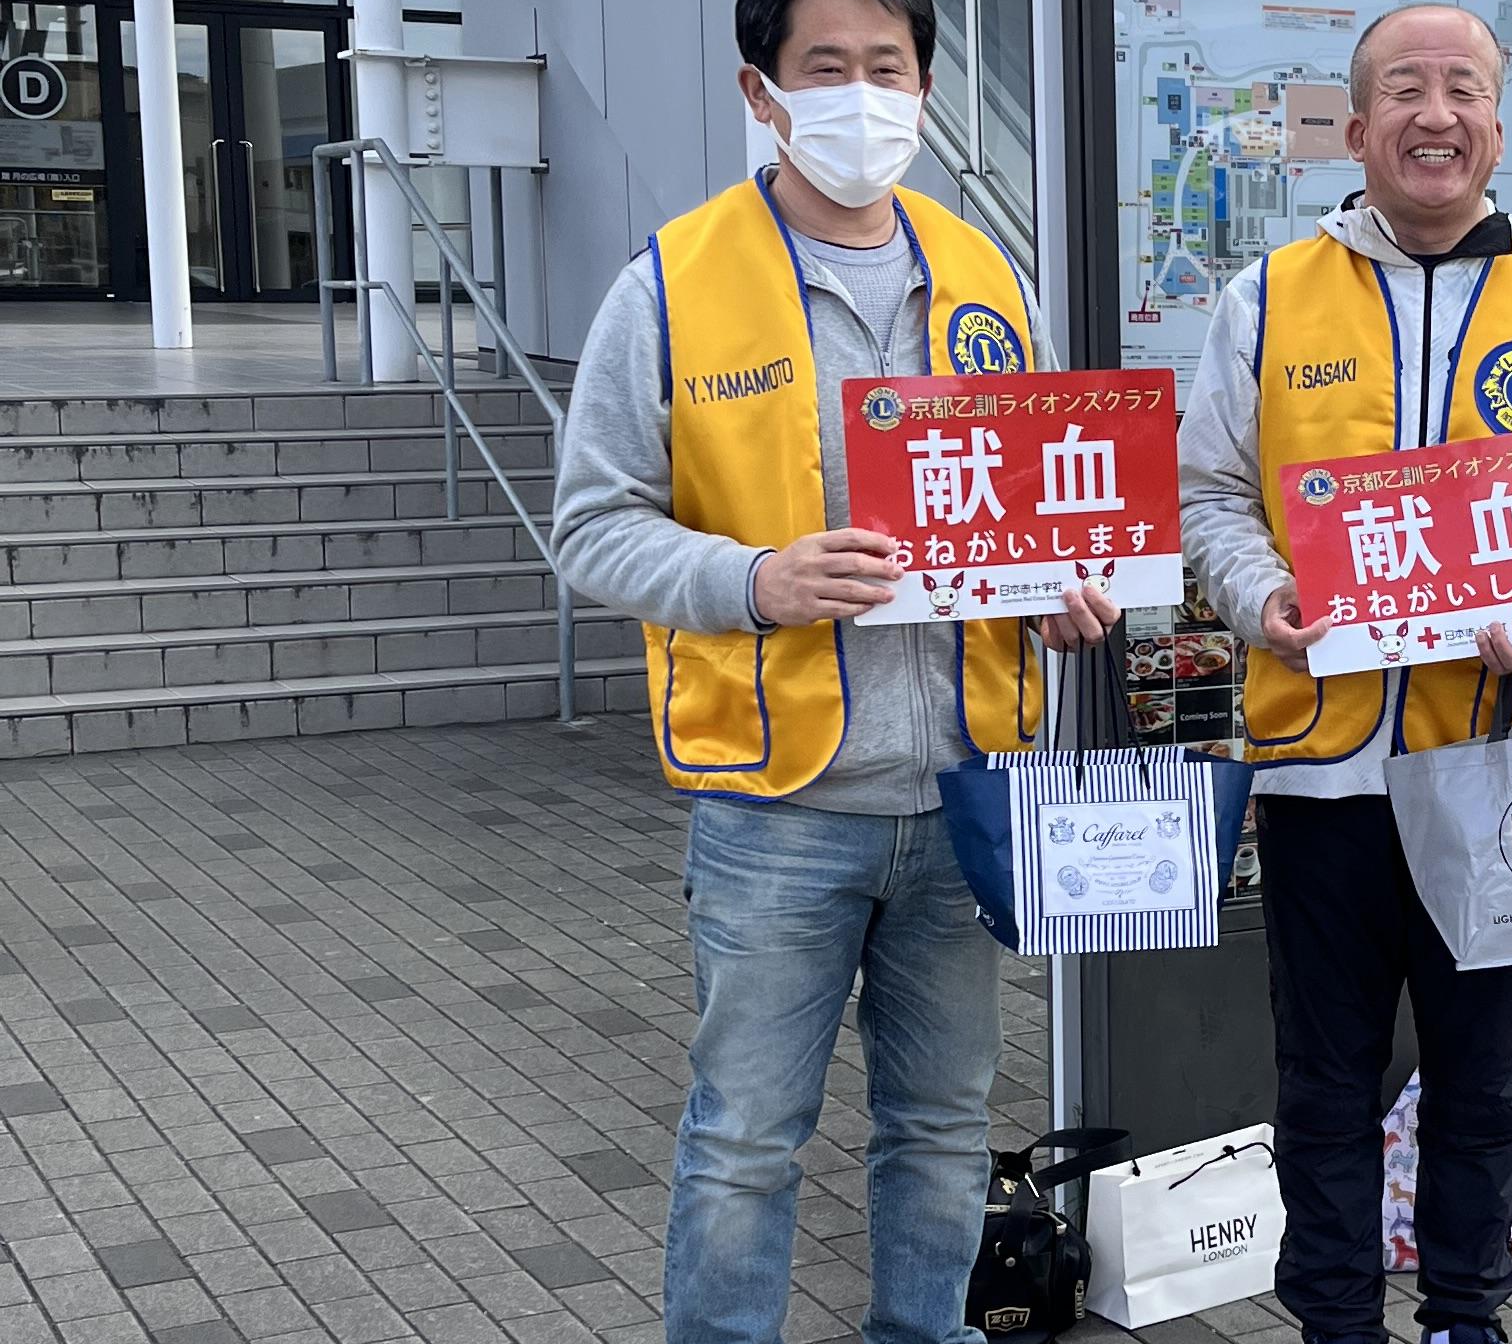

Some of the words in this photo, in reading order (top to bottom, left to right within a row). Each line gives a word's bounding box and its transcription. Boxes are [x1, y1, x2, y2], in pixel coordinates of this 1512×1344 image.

[18, 71, 49, 104] D
[963, 314, 1003, 337] LIONS
[978, 338, 1000, 372] L
[684, 357, 794, 404] Y.YAMAMOTO
[1284, 357, 1357, 390] Y.SASAKI
[908, 387, 1165, 420] 京都乙訓ライオンズクラブ
[906, 423, 1125, 528] 献血
[885, 520, 1155, 568] おねがいします
[1180, 712, 1208, 722] Coming
[1209, 711, 1229, 720] Soon
[1082, 823, 1149, 850] Caffarel
[1190, 1213, 1257, 1253] HENRY
[1202, 1243, 1248, 1263] LONDON
[990, 1312, 1026, 1324] ZETT
